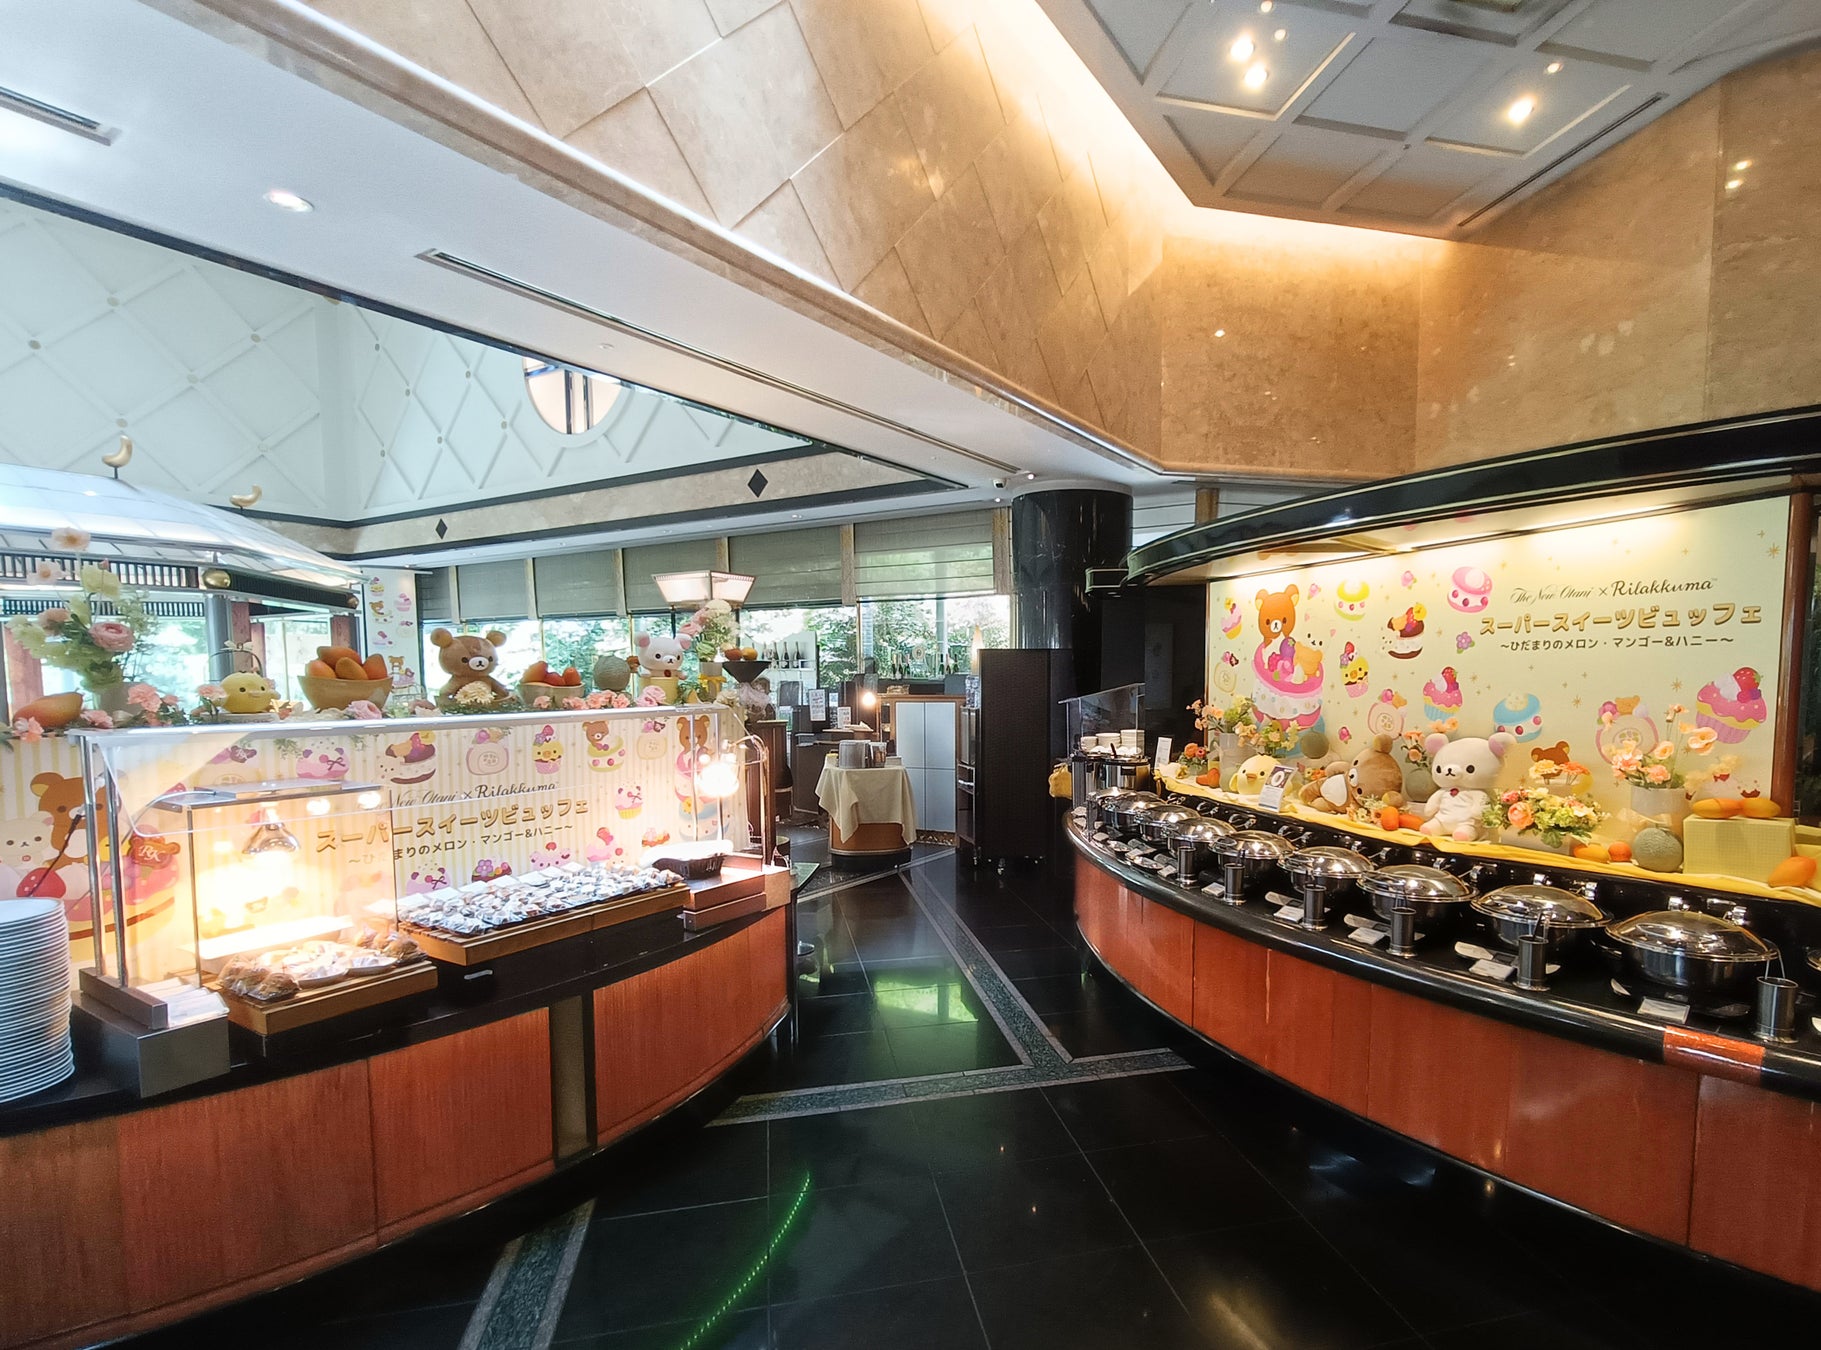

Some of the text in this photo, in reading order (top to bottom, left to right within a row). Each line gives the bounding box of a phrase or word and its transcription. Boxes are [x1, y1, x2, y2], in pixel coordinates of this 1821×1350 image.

[1559, 585, 1594, 600] Otani
[1480, 602, 1762, 635] スーパースイーツビュッフェ
[316, 798, 589, 853] スーパースイーツビュッフェ
